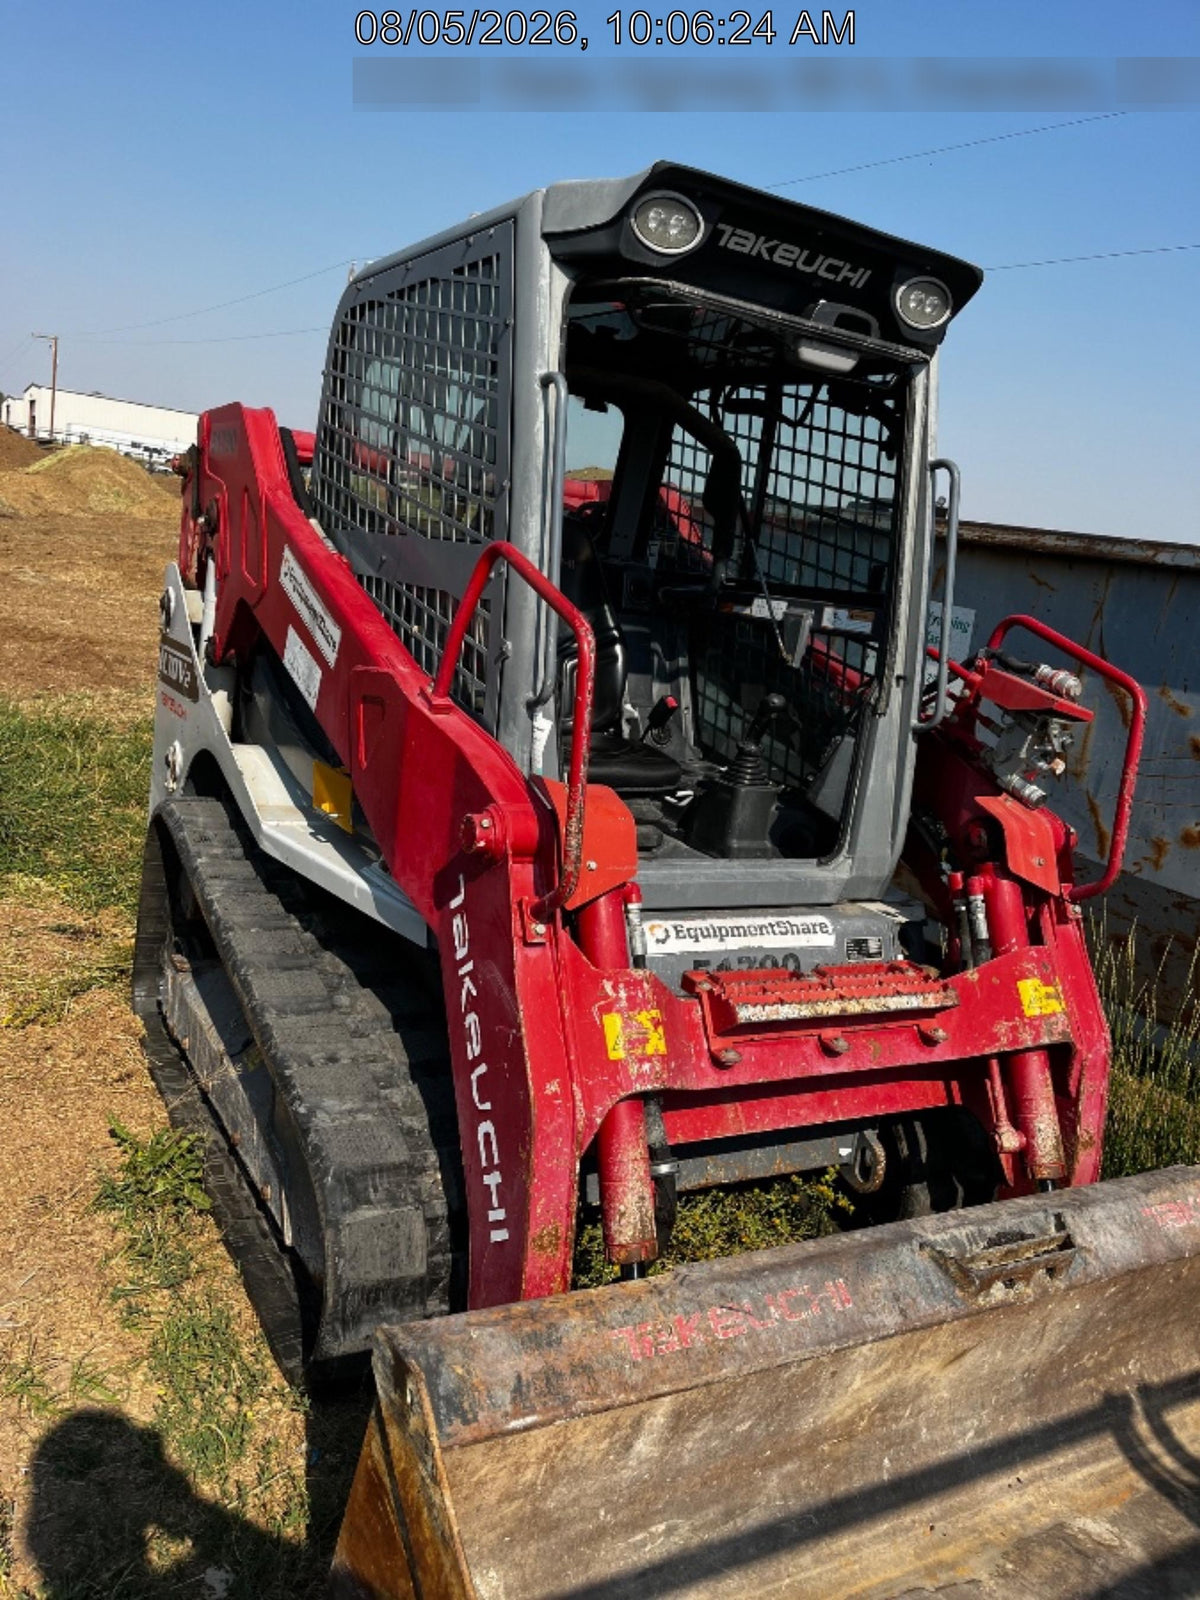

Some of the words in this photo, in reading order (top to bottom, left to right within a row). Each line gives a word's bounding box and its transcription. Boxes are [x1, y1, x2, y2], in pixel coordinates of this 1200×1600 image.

[716, 222, 872, 289] TAKEUCHI
[674, 920, 830, 942] EquipmentShare
[448, 872, 509, 1243] TAKEUCHI
